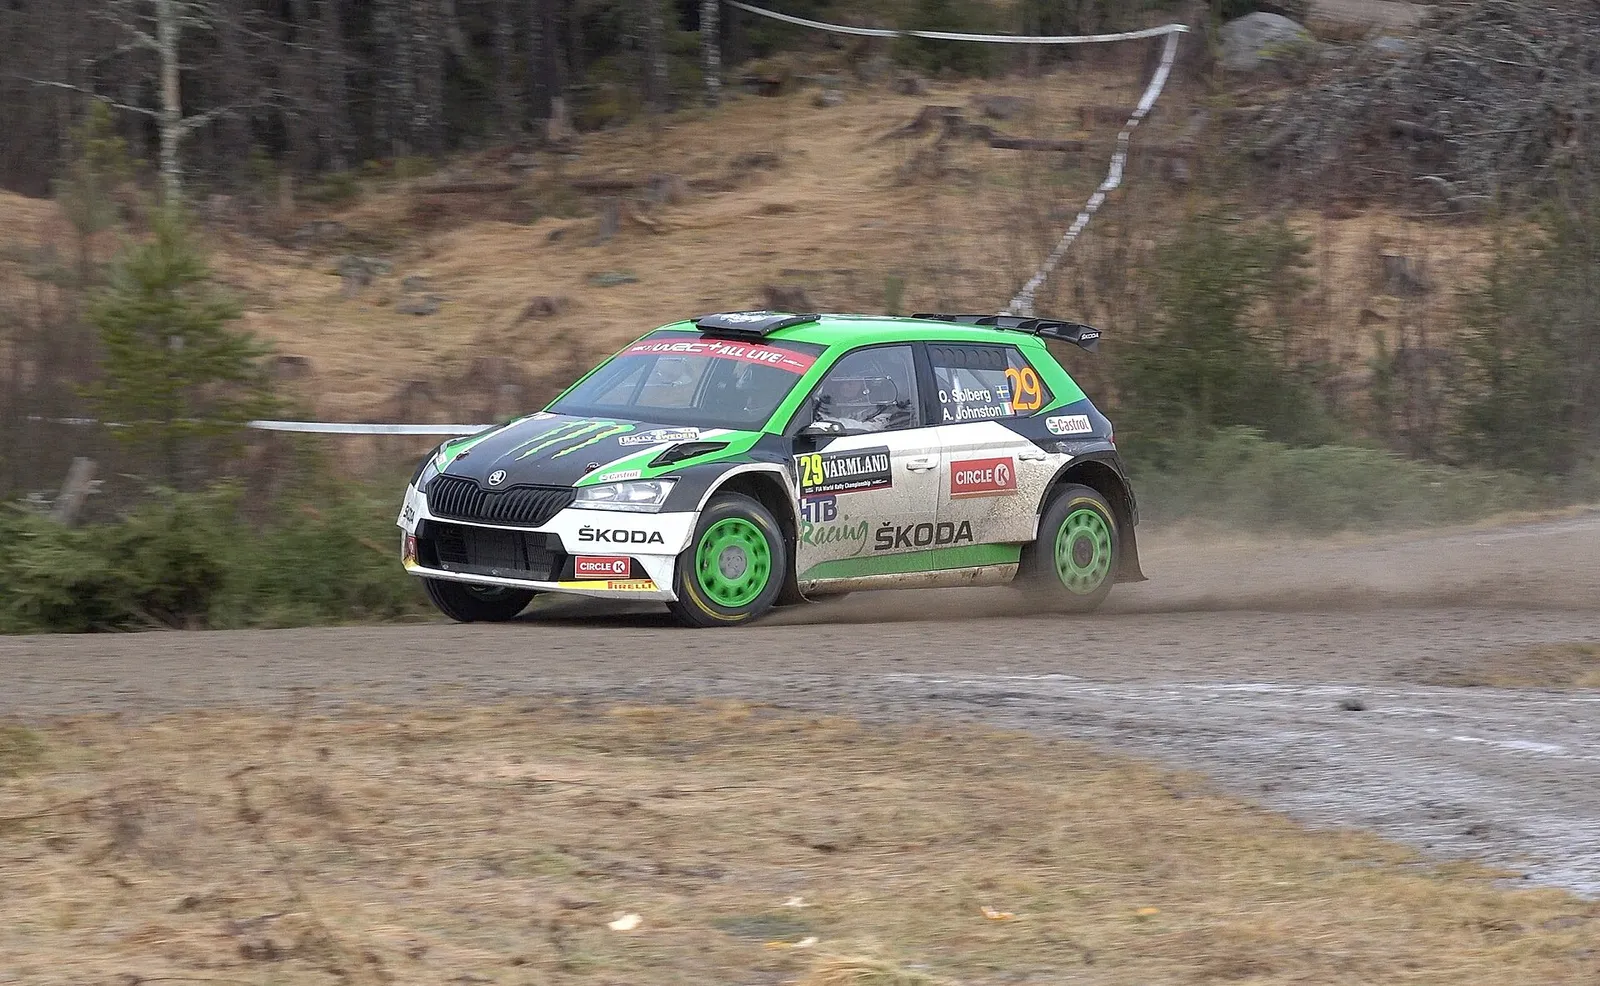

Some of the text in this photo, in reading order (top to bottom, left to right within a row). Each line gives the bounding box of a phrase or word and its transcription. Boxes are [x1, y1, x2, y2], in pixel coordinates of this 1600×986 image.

[716, 345, 746, 357] ALL
[746, 348, 782, 364] LIVE
[938, 388, 992, 403] O. Solberg
[1004, 367, 1042, 411] 29
[943, 405, 1003, 421] A. Johnston
[1057, 417, 1090, 432] Castrol
[801, 454, 824, 488] 29
[822, 454, 889, 479] VÄRMLAND
[955, 468, 993, 485] CIRCLE
[798, 495, 838, 523] HTB
[578, 524, 665, 545] ŠKODA
[800, 514, 868, 557] Racing
[874, 520, 974, 551] ŠKODA
[579, 562, 612, 571] CIRCLE
[607, 580, 653, 590] PIRELLI
